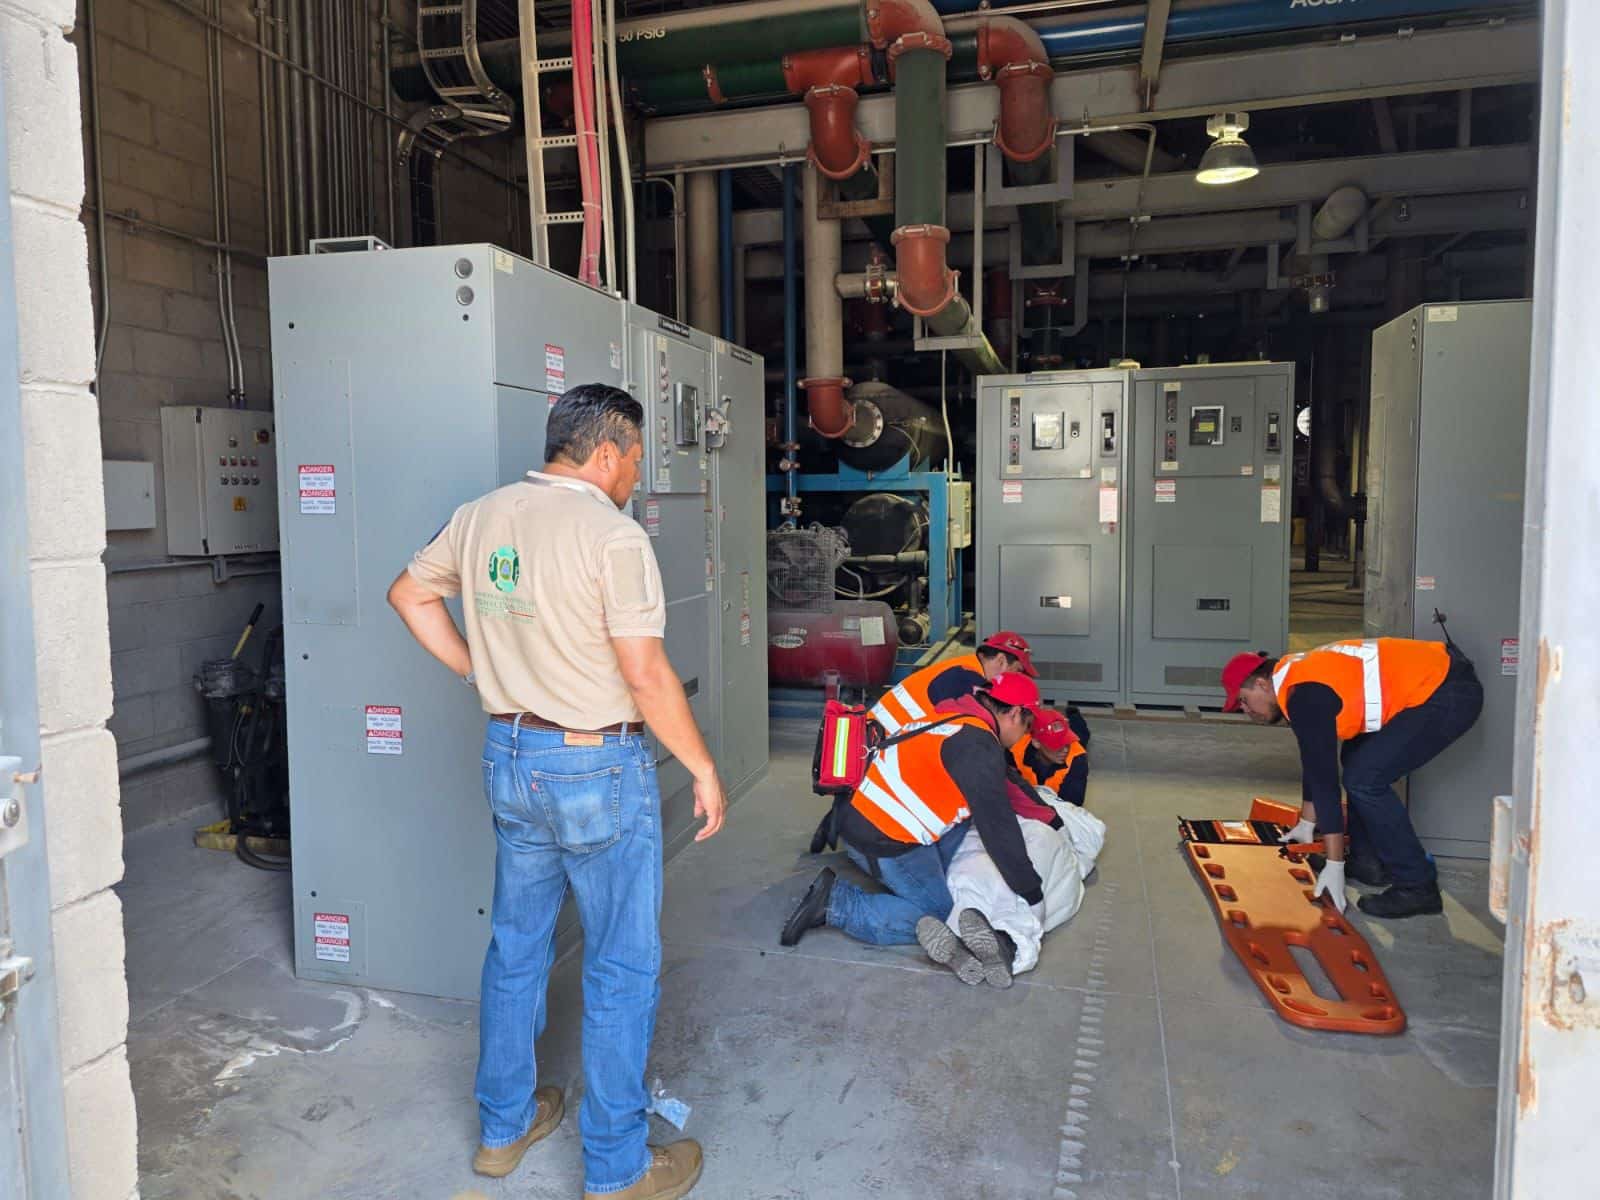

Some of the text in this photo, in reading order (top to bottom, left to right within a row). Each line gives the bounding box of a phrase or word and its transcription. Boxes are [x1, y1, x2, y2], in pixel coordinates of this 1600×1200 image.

[636, 26, 666, 41] PSIG
[372, 706, 400, 714] DANGER
[373, 730, 401, 738] DANGER
[320, 914, 348, 923] DANGER
[319, 937, 348, 945] DANGER
